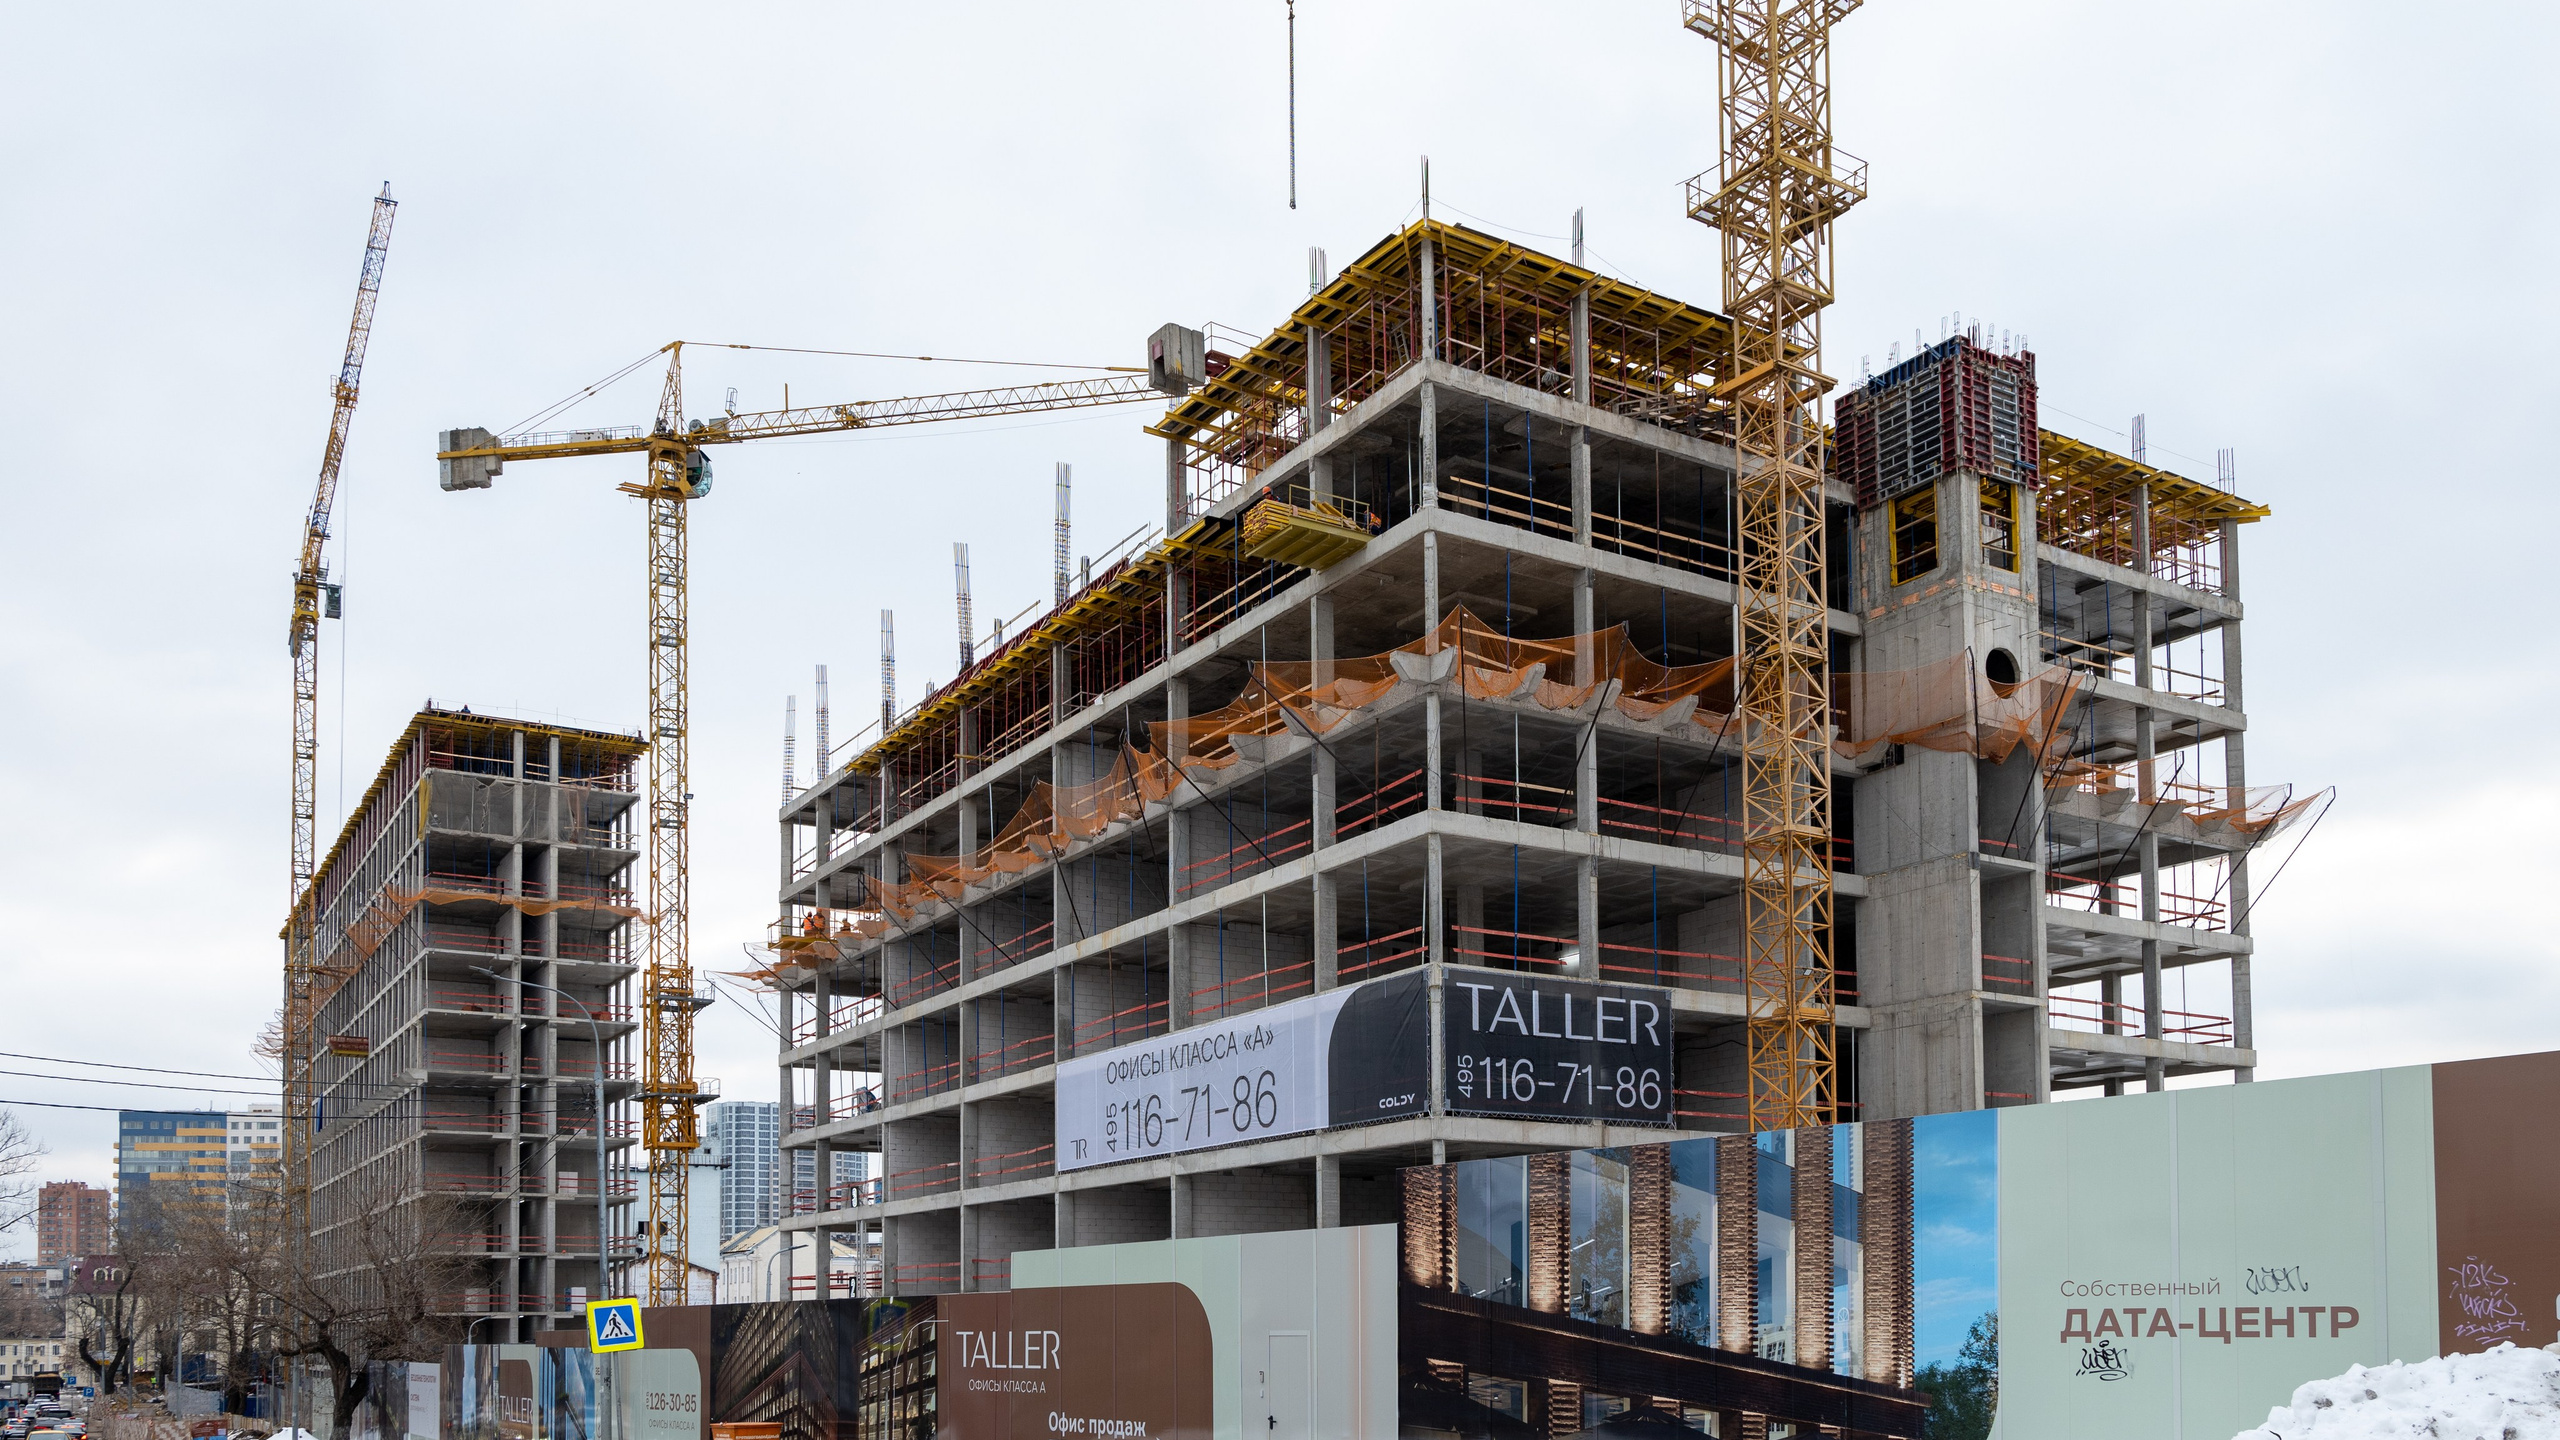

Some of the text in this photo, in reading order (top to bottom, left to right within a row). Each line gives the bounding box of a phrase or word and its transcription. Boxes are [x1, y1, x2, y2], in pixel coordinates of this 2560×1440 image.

[1456, 982, 1661, 1046] TALLER
[1106, 1024, 1274, 1084] ОФИСЫ КЛАССА «А»
[1457, 1054, 1662, 1110] 495 116-71-86
[1106, 1070, 1277, 1153] 495 116-71-86
[2060, 1277, 2221, 1297] Собственный
[2060, 1306, 2360, 1345] ДАТА-ЦЕНТР
[956, 1330, 1061, 1370] TALLER
[650, 1392, 697, 1413] 126-30-85
[968, 1378, 1047, 1394] ОФИСЫ КЛАССА А
[499, 1395, 534, 1425] TALLER
[648, 1418, 668, 1429] ОФИСЫ
[669, 1420, 690, 1431] КЛАССА
[1048, 1411, 1147, 1440] Офис продаж
